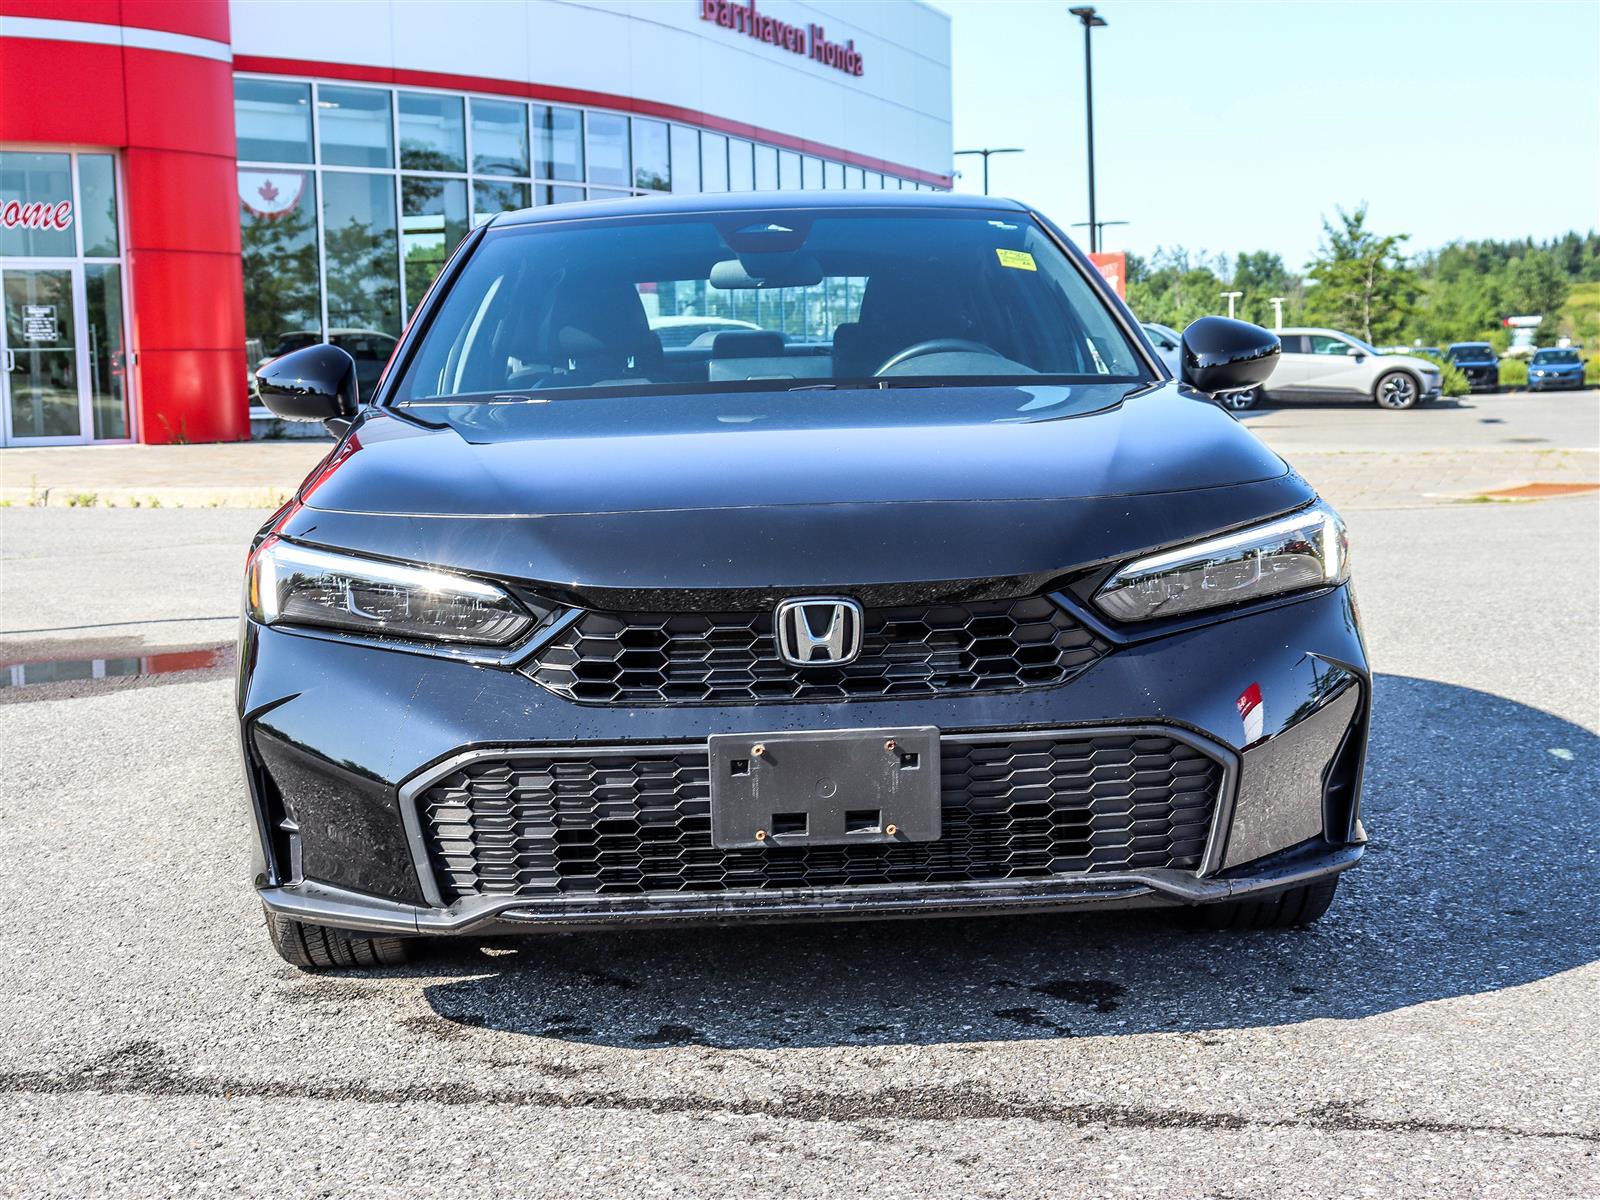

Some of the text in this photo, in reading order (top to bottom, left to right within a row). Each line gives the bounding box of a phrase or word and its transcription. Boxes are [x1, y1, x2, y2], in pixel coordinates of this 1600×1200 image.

[700, 0, 863, 77] Barrhaven Honda
[0, 199, 74, 231] ome
